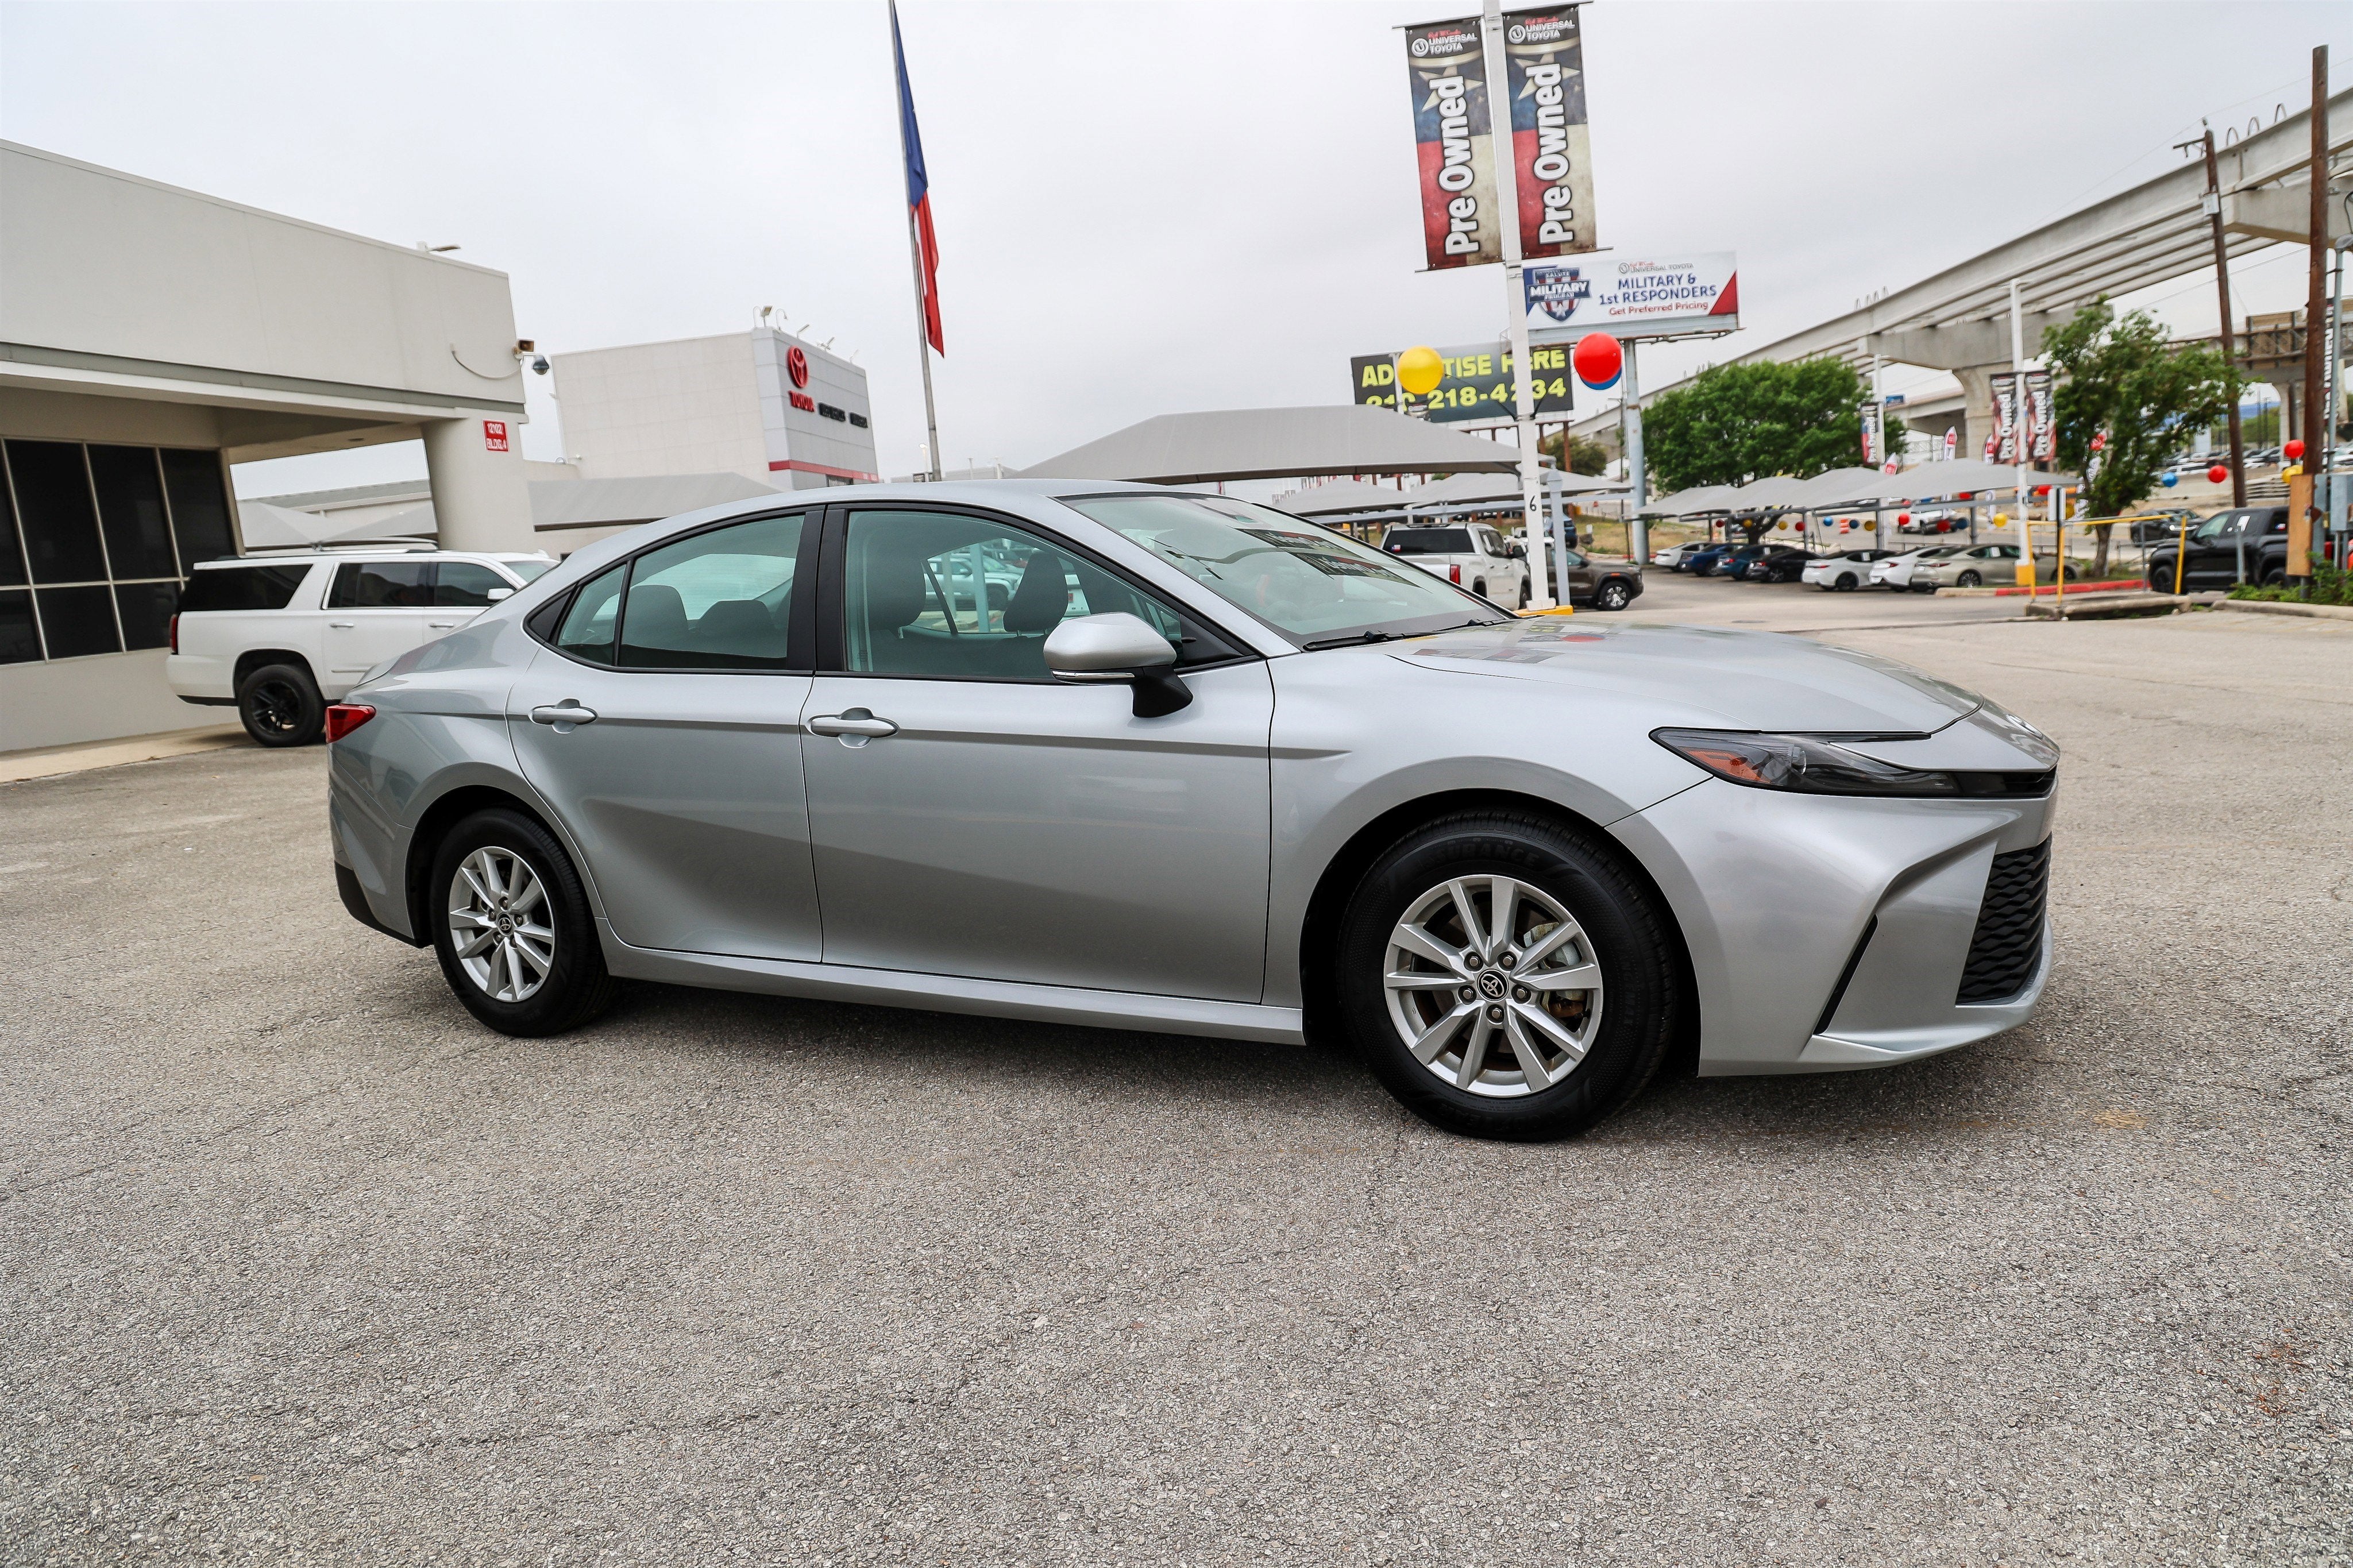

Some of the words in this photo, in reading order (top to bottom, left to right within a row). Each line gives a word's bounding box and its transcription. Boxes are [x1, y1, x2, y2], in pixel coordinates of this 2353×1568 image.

[1525, 20, 1575, 33] UNIVERSAL
[1526, 29, 1561, 42] TOYOTA
[1428, 33, 1478, 45] UNIVERSAL
[1429, 42, 1463, 55] TOYOTA
[1525, 63, 1569, 181] Owned
[1429, 75, 1474, 192] Owned
[1445, 196, 1480, 256] Pre
[1538, 186, 1573, 245] Pre
[1530, 281, 1587, 297] MILITARY
[1618, 273, 1684, 290] MILITARY
[1687, 272, 1697, 285] &
[1599, 293, 1619, 305] 1st
[1623, 284, 1717, 303] RESPONDERS
[1609, 307, 1626, 315] Get
[1629, 302, 1673, 314] Preferred
[1676, 301, 1709, 311] Pricing
[1500, 349, 1565, 374] HRE
[1997, 393, 2013, 438] Owned
[2031, 391, 2047, 435] Owned
[487, 423, 503, 435] 12102
[1999, 438, 2013, 460] Pre
[2033, 435, 2048, 457] Pre
[1530, 495, 1537, 511] 6
